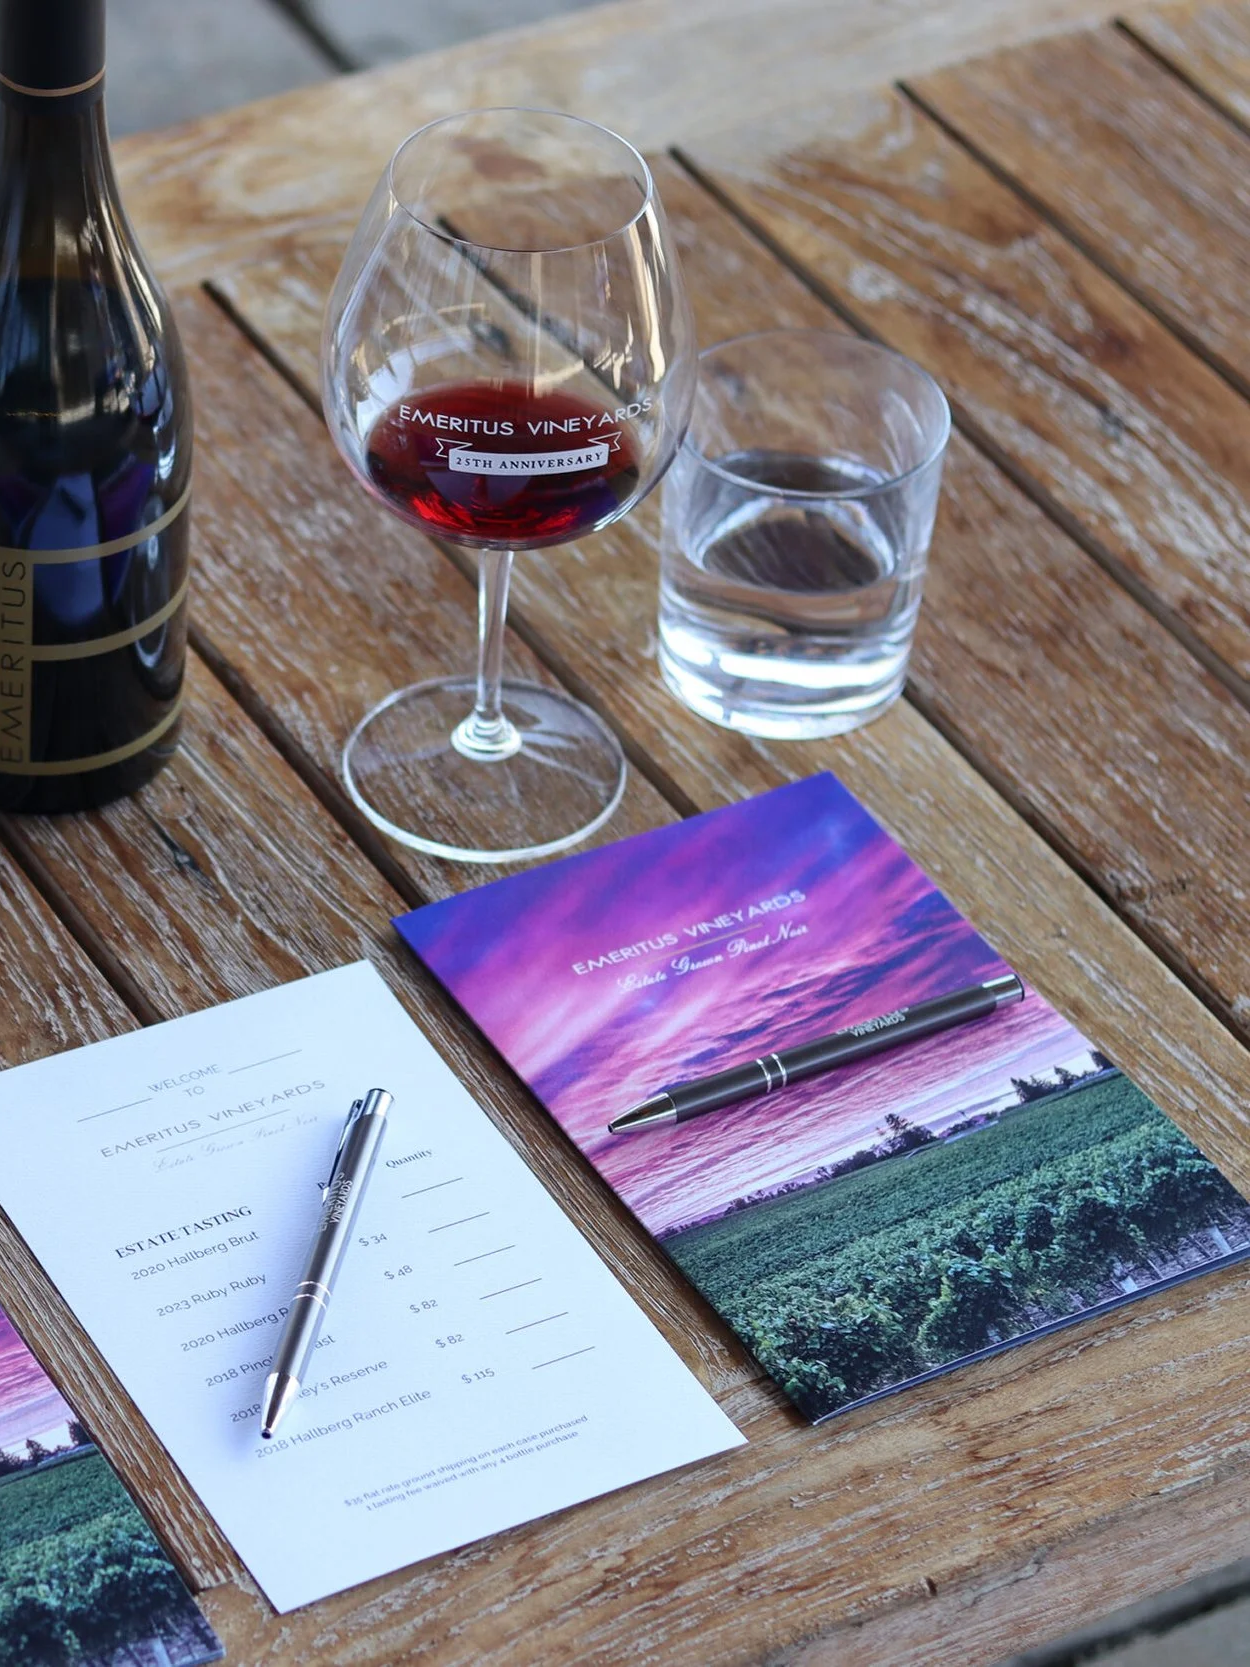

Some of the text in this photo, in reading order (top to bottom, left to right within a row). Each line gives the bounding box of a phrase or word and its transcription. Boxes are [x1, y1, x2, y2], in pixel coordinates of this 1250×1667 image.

[399, 397, 652, 436] EMERITUS VINEYARDS
[456, 451, 604, 470] 25TH ANNIVERSARY
[1, 561, 26, 763] EMERITUS
[572, 889, 807, 976] EMERITUS VINEYARDS
[617, 921, 809, 995] Estate Grown Pinot Noir
[849, 1010, 906, 1037] VINEYARDS
[148, 1063, 222, 1093] WELCOME
[185, 1085, 206, 1098] TO
[100, 1079, 326, 1158] EMERITUS VINEYARDS
[385, 1148, 434, 1169] Quantity
[329, 1180, 354, 1223] VINEYARDS
[115, 1205, 252, 1259] ESTATE TASTING
[358, 1233, 388, 1247] $ 34
[131, 1231, 260, 1281] 2020 Hallberg Brut
[384, 1264, 414, 1281] $ 48
[156, 1273, 267, 1317] 2023 Ruby Ruby
[409, 1298, 439, 1314] $ 82
[180, 1334, 216, 1352] 2020
[216, 1313, 279, 1340] Hallberg
[435, 1333, 465, 1348] $ 82
[204, 1368, 239, 1387] 2018
[230, 1403, 262, 1423] 2018
[330, 1359, 389, 1387] Reserve
[461, 1367, 496, 1385] $ 115
[255, 1388, 432, 1459] 2018 Hallberg Ranch Elite
[535, 1430, 579, 1452] purchase
[437, 1455, 478, 1475] shipping
[478, 1451, 491, 1460] on
[516, 1434, 538, 1446] case
[538, 1414, 589, 1439] purchased
